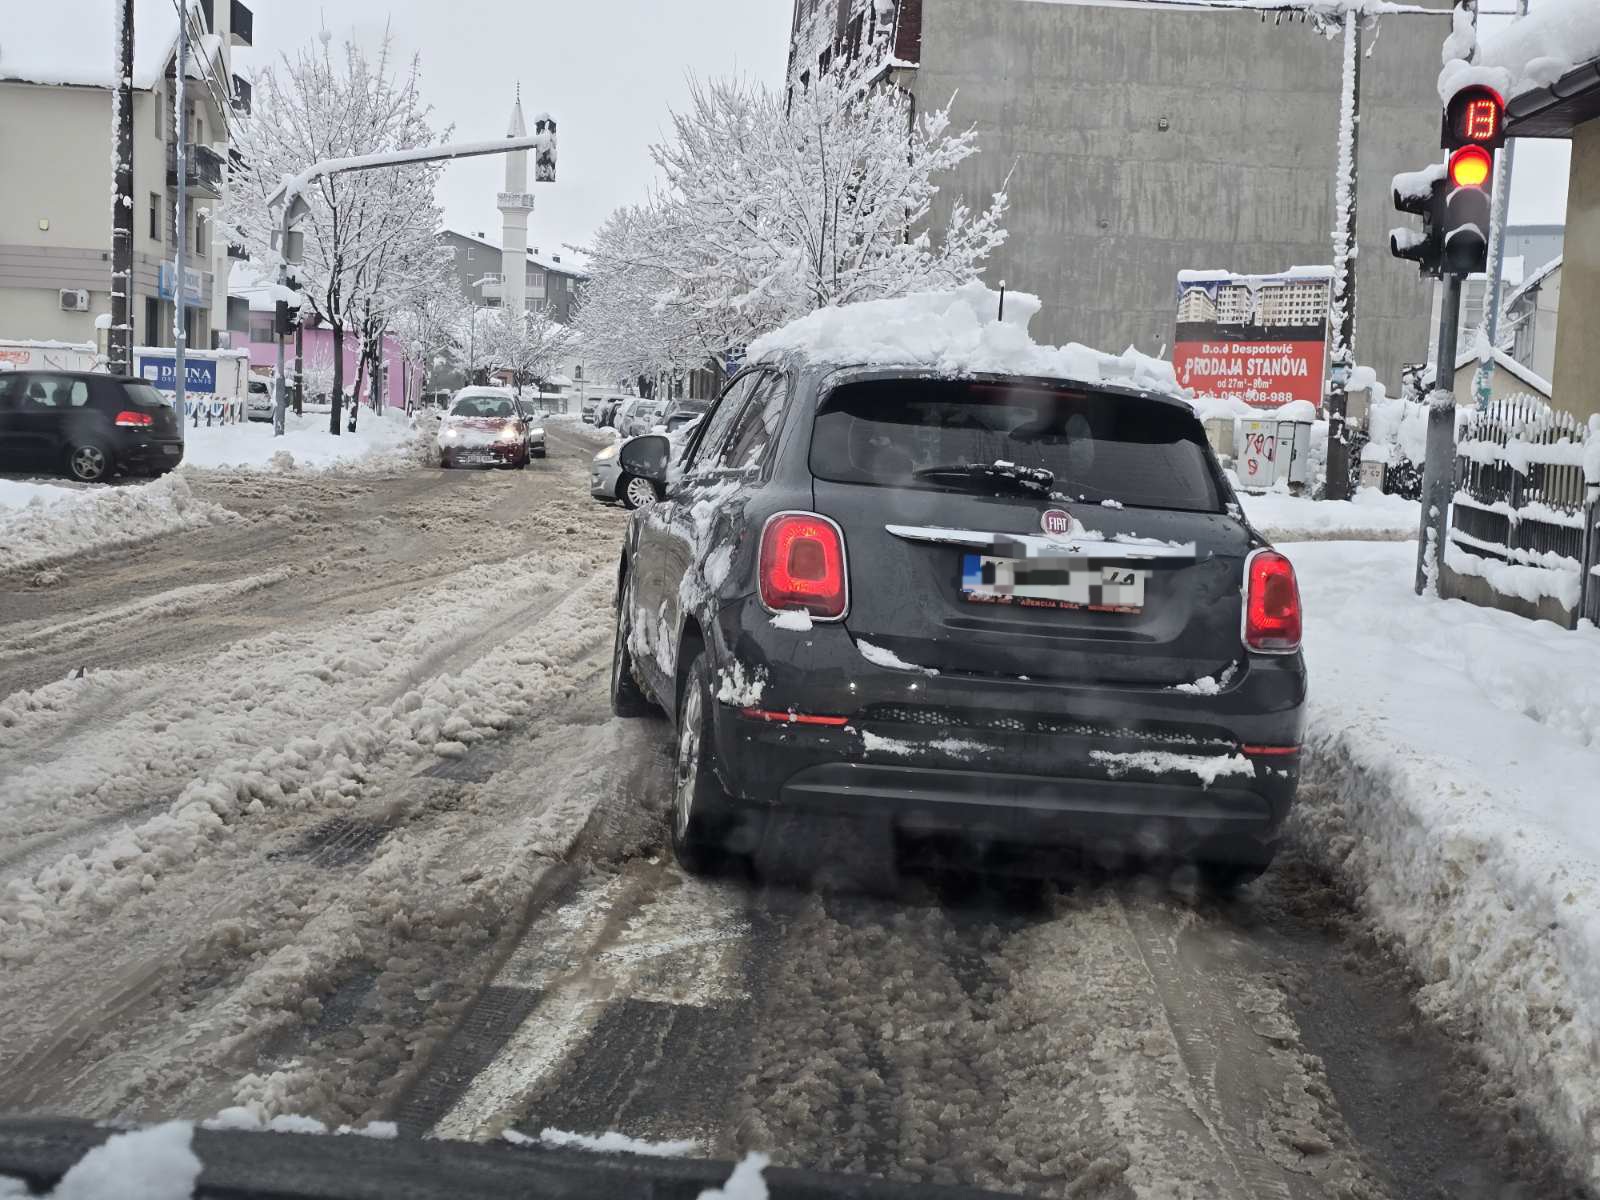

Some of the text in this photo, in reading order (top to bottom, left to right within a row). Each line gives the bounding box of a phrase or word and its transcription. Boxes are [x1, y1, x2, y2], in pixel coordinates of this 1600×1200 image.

[1467, 100, 1495, 138] 13
[1232, 344, 1293, 355] Despotović
[162, 366, 211, 379] DINA
[1185, 357, 1308, 376] PRODAJA STANOVA
[1217, 378, 1227, 388] od
[1049, 517, 1067, 531] FIAT
